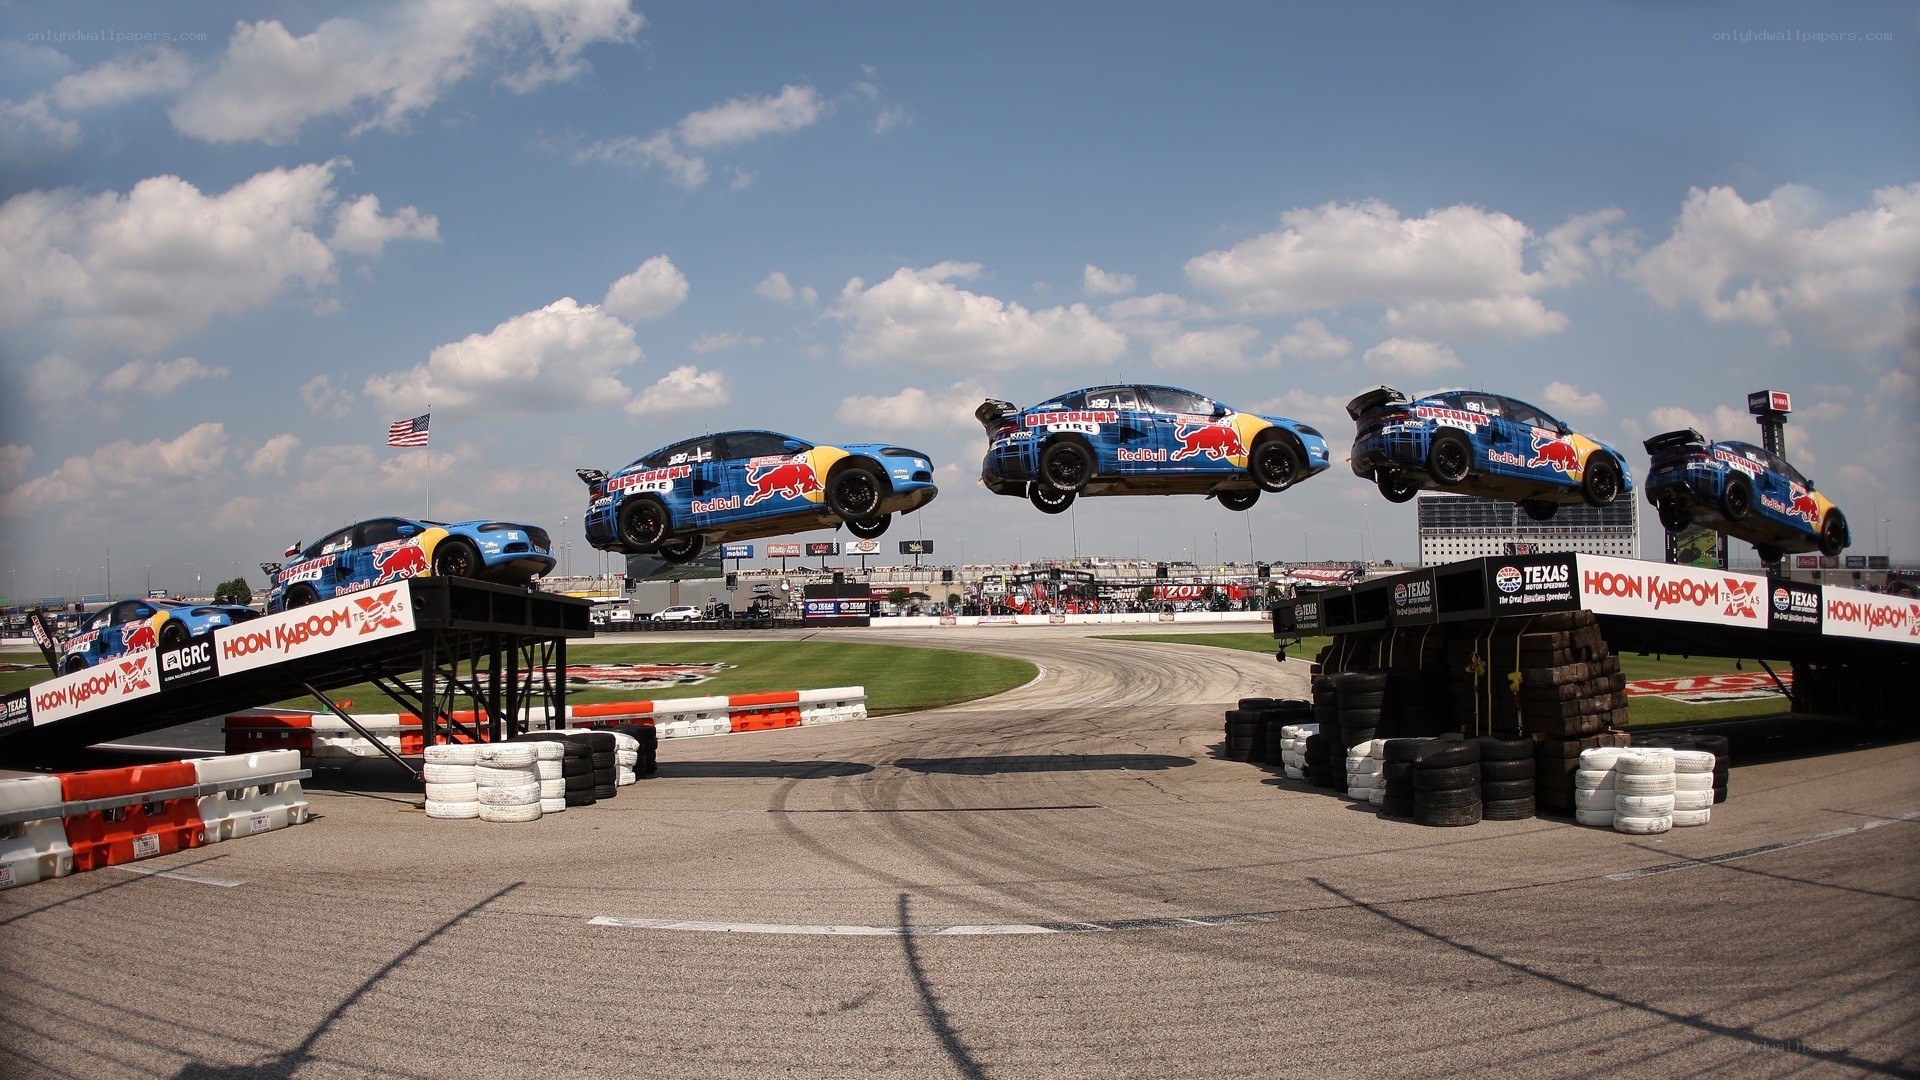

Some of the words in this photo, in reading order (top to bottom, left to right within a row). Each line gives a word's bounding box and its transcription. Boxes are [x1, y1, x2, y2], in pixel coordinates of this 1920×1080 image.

[1025, 411, 1119, 427] DISCOUNT
[1416, 406, 1490, 426] DISCOUNT
[1440, 419, 1473, 431] TIRE
[1053, 423, 1094, 433] TIRE
[1118, 448, 1142, 461] Red
[1143, 448, 1167, 461] Bull
[1713, 449, 1764, 474] DISCOUNT
[607, 465, 692, 493] DISCOUNT
[630, 481, 667, 492] TIRE
[692, 500, 716, 513] Red
[716, 495, 740, 511] Bull
[278, 554, 336, 583] DISCOUNT
[1524, 564, 1569, 583] TEXAS
[1407, 580, 1430, 598] TEXAS
[1525, 583, 1543, 591] MOTOR
[1543, 582, 1568, 590] SPEEDWAY
[1584, 570, 1643, 599] HOON
[1647, 575, 1719, 610] KABOOM
[1499, 595, 1508, 604] The
[1790, 591, 1818, 607] TEXAS
[1303, 602, 1317, 615] TEXAS
[1827, 599, 1862, 622] HOON
[1864, 603, 1907, 632] KABOOM
[63, 630, 99, 652] DISCOUNT
[223, 630, 272, 660] HOON
[274, 606, 352, 654] KABOOM
[181, 642, 211, 667] GRC
[35, 688, 67, 713] HOON
[68, 669, 118, 709] KABOOM
[7, 697, 27, 712] TEXAS
